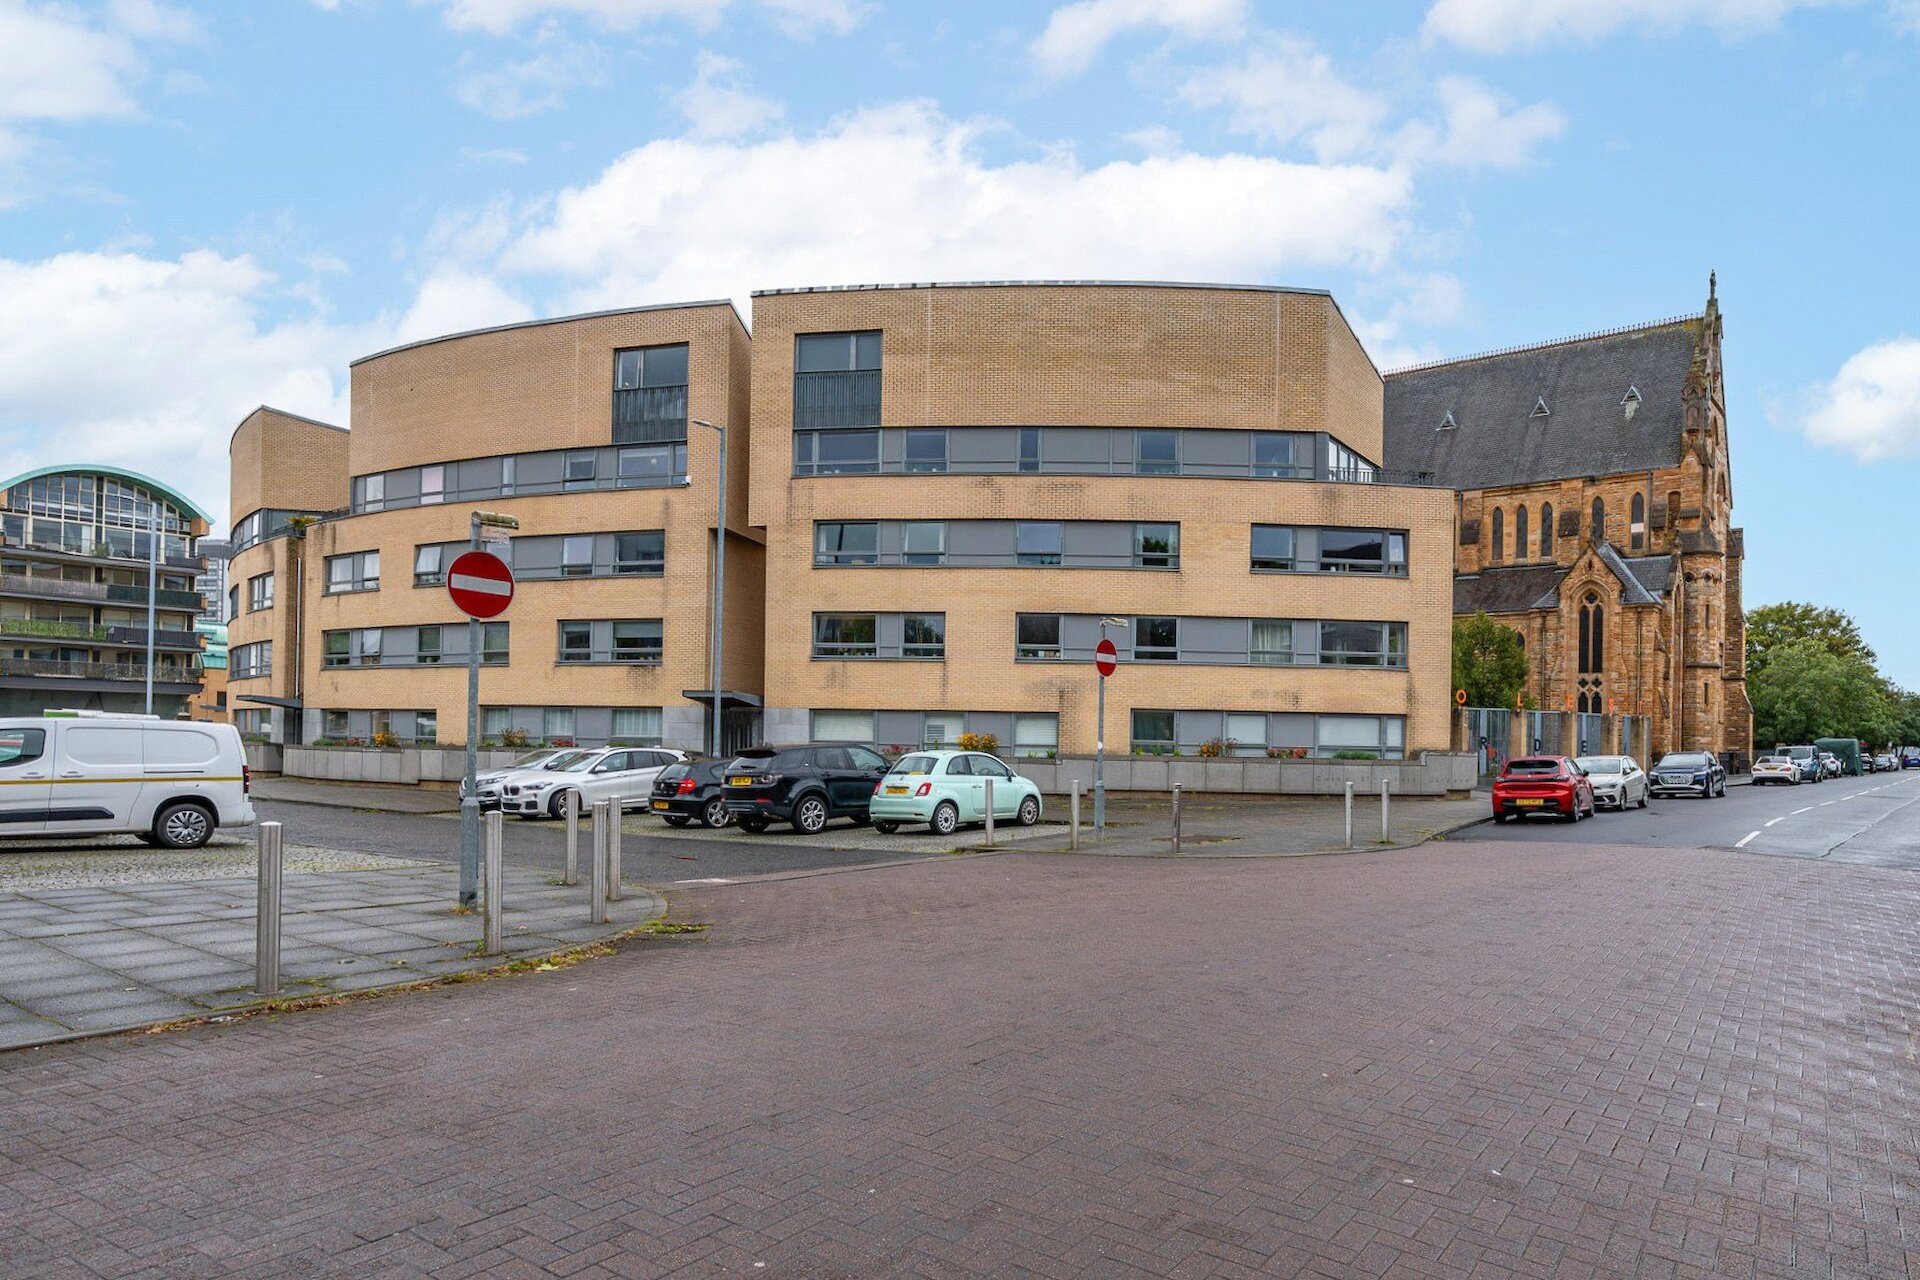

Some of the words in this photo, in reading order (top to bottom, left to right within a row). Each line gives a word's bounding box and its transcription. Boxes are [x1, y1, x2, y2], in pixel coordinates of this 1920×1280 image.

[1456, 689, 1467, 704] O
[1517, 692, 1523, 706] L
[1534, 739, 1541, 752] D
